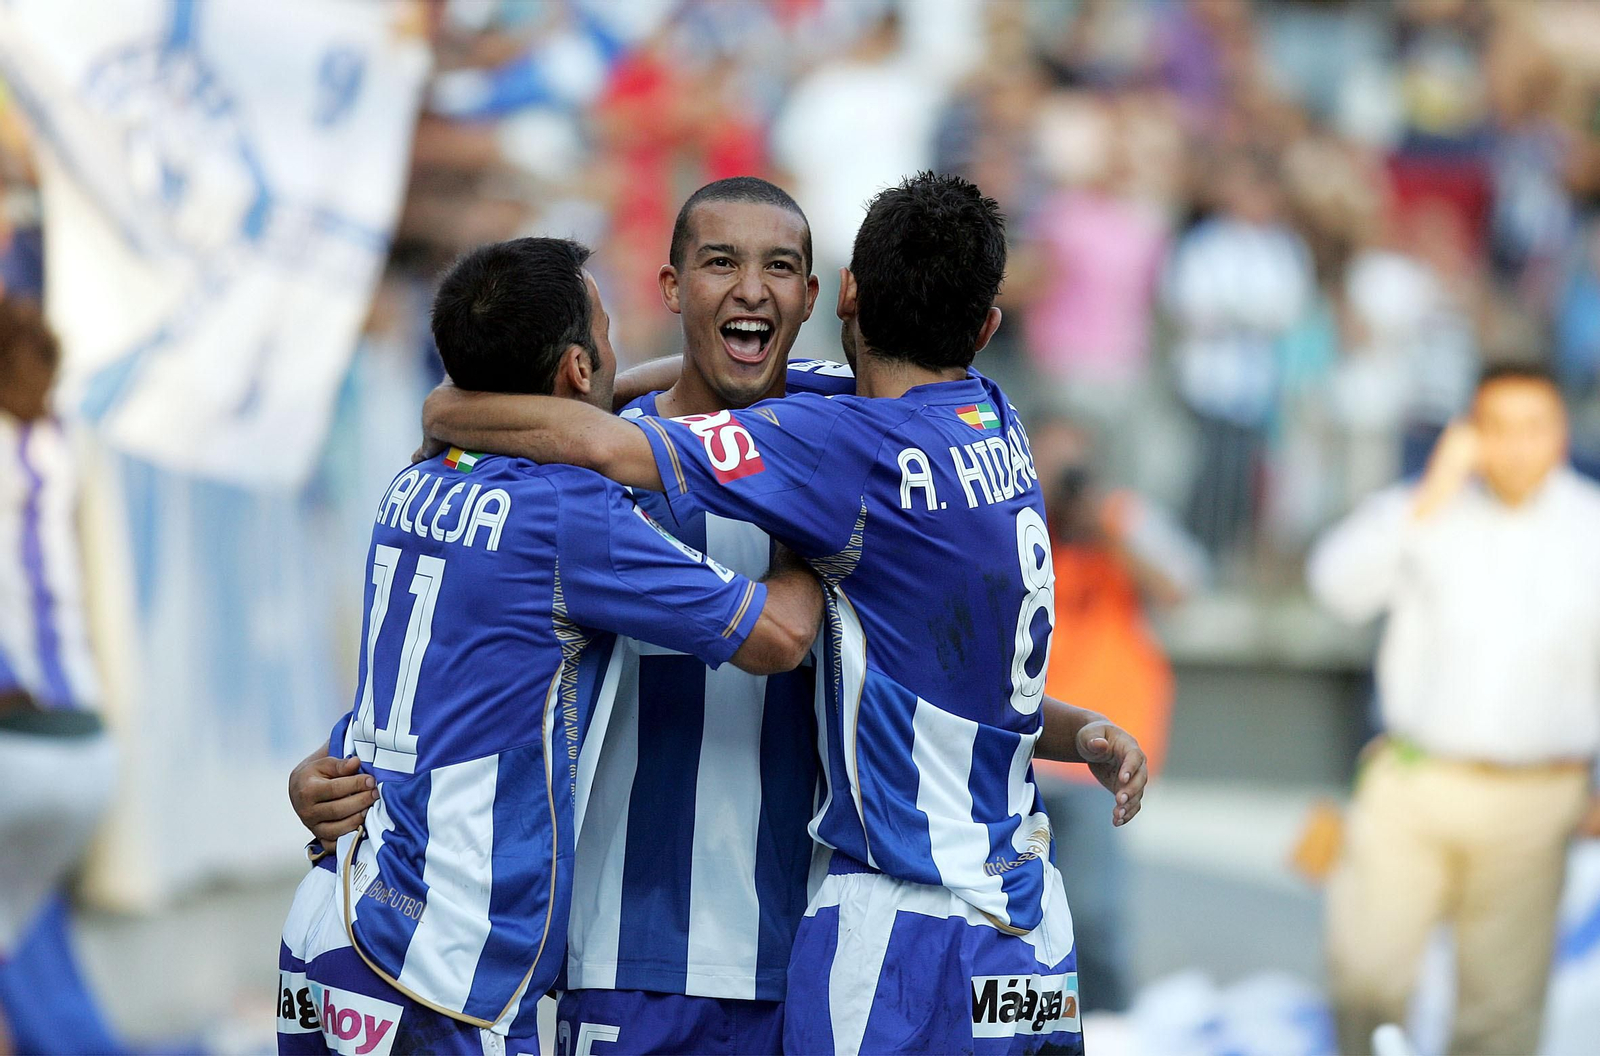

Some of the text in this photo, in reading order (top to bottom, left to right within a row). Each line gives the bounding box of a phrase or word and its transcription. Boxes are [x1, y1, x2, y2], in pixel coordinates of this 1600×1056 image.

[949, 416, 1038, 509] HIDAL
[353, 543, 447, 775] 11
[1009, 507, 1056, 716] 8
[277, 973, 394, 1055] lag hoy
